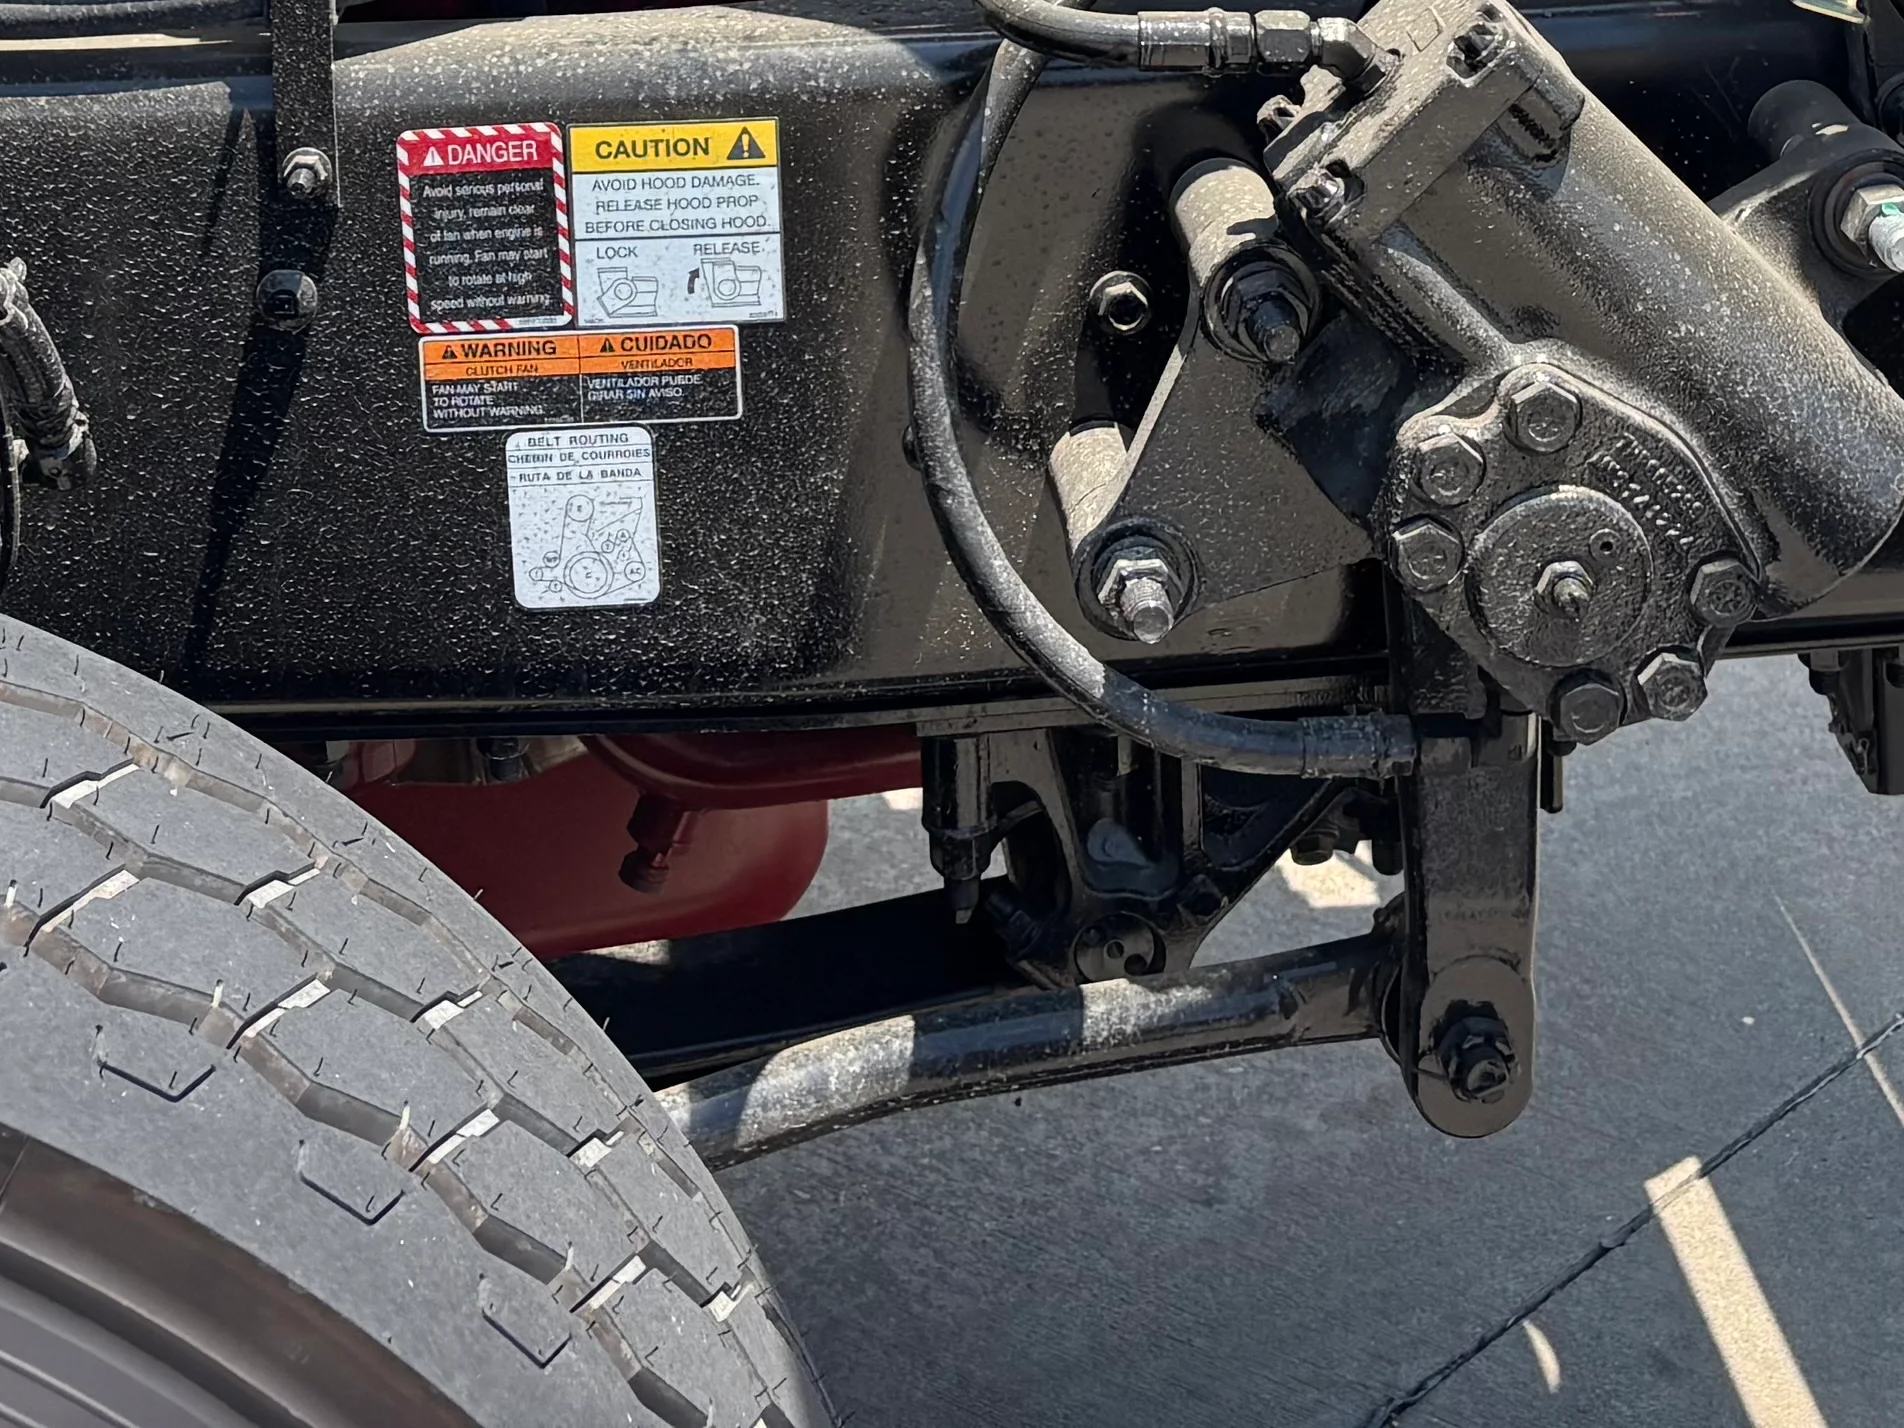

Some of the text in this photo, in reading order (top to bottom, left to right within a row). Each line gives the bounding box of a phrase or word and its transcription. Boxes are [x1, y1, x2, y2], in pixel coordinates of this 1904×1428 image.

[448, 140, 538, 165] DANGER
[595, 137, 711, 159] CAUTION
[423, 178, 544, 197] Avoid serious personal
[592, 174, 760, 192] AVOID HOOD DAMAGE.
[469, 206, 506, 218] remain
[509, 204, 535, 214] clear
[596, 195, 759, 212] RELEASE HOOD PROP
[585, 215, 770, 234] BEFORE CLOSING HOOD.
[475, 250, 495, 262] Fan
[498, 249, 520, 263] may
[524, 248, 548, 259] start
[597, 246, 638, 260] LOCK
[693, 242, 760, 256] RELEASE
[431, 296, 464, 310] speed
[467, 295, 504, 308] without
[461, 340, 557, 358] WARNING
[620, 334, 712, 352] CUIDADO
[466, 364, 538, 376] CLUTCH FAN
[621, 358, 693, 370] VENTILADOR
[432, 382, 518, 394] FAN MAY START
[587, 374, 703, 389] VENTILADOR PUEDE
[433, 396, 494, 406] TO ROTATE
[588, 389, 623, 400] GIRAR
[627, 389, 645, 399] SIN
[434, 405, 545, 419] WITHOUT WARNING.
[528, 433, 629, 447] BELT ROUTING
[519, 467, 641, 483] RUTA DE LA BANDA
